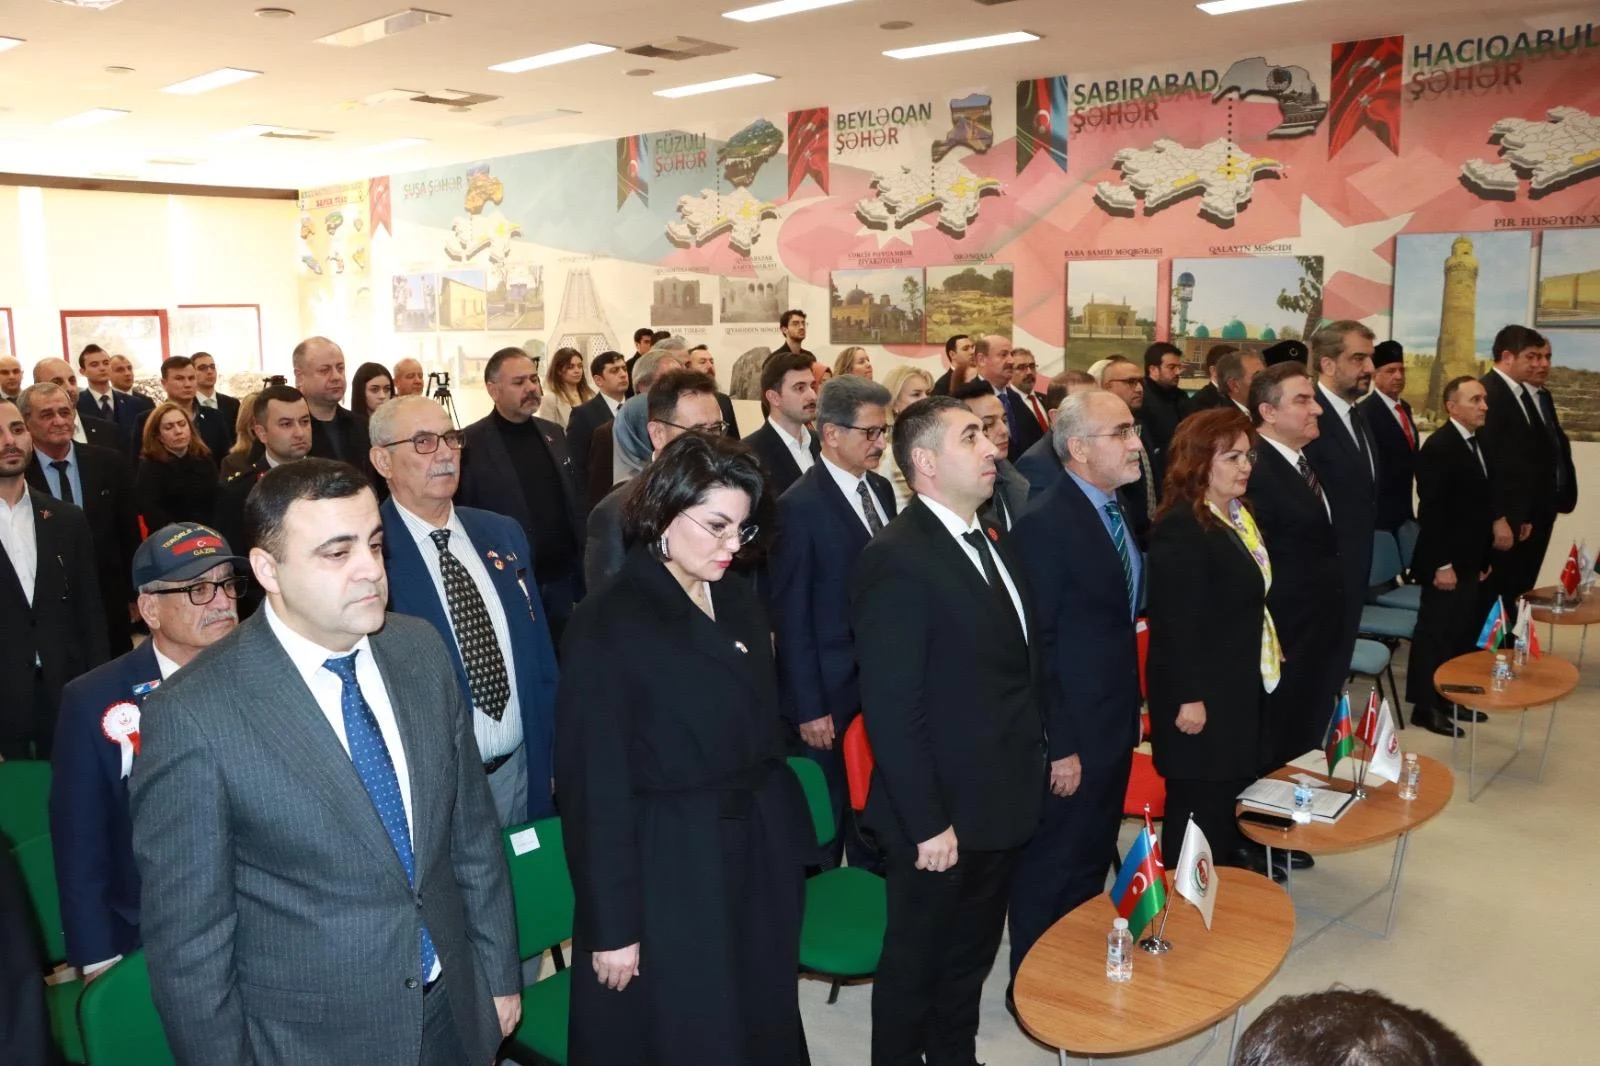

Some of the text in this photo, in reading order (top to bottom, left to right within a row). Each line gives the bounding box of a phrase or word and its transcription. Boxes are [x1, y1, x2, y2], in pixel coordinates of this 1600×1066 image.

[1073, 69, 1219, 106] SABIRABAD
[1410, 61, 1523, 100] ŞƏHƏR
[836, 101, 932, 131] BEYLƏQAN
[1073, 100, 1160, 134] ŞƏHƏR
[835, 126, 899, 155] ŞƏHƏR
[655, 149, 708, 177] ŞƏHƏR
